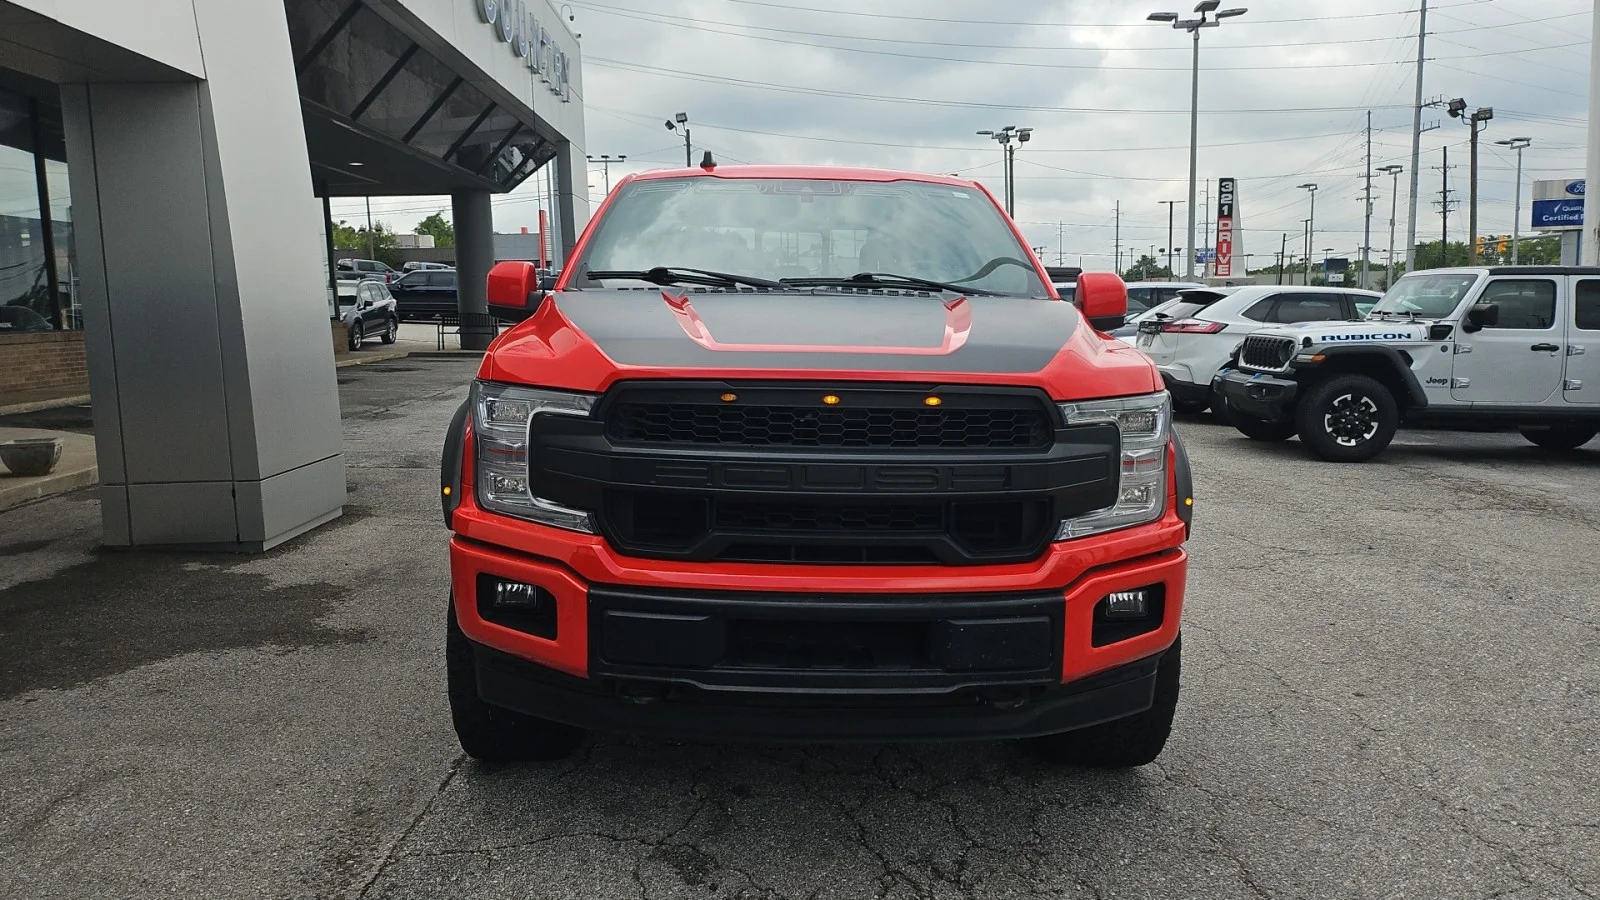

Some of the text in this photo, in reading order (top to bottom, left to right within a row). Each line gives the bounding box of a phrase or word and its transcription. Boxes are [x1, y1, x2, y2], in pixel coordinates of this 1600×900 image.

[1542, 214, 1579, 222] Certified
[1321, 333, 1412, 342] RUBICON
[1425, 376, 1448, 386] Jeep
[650, 464, 1012, 490] ROUSH
